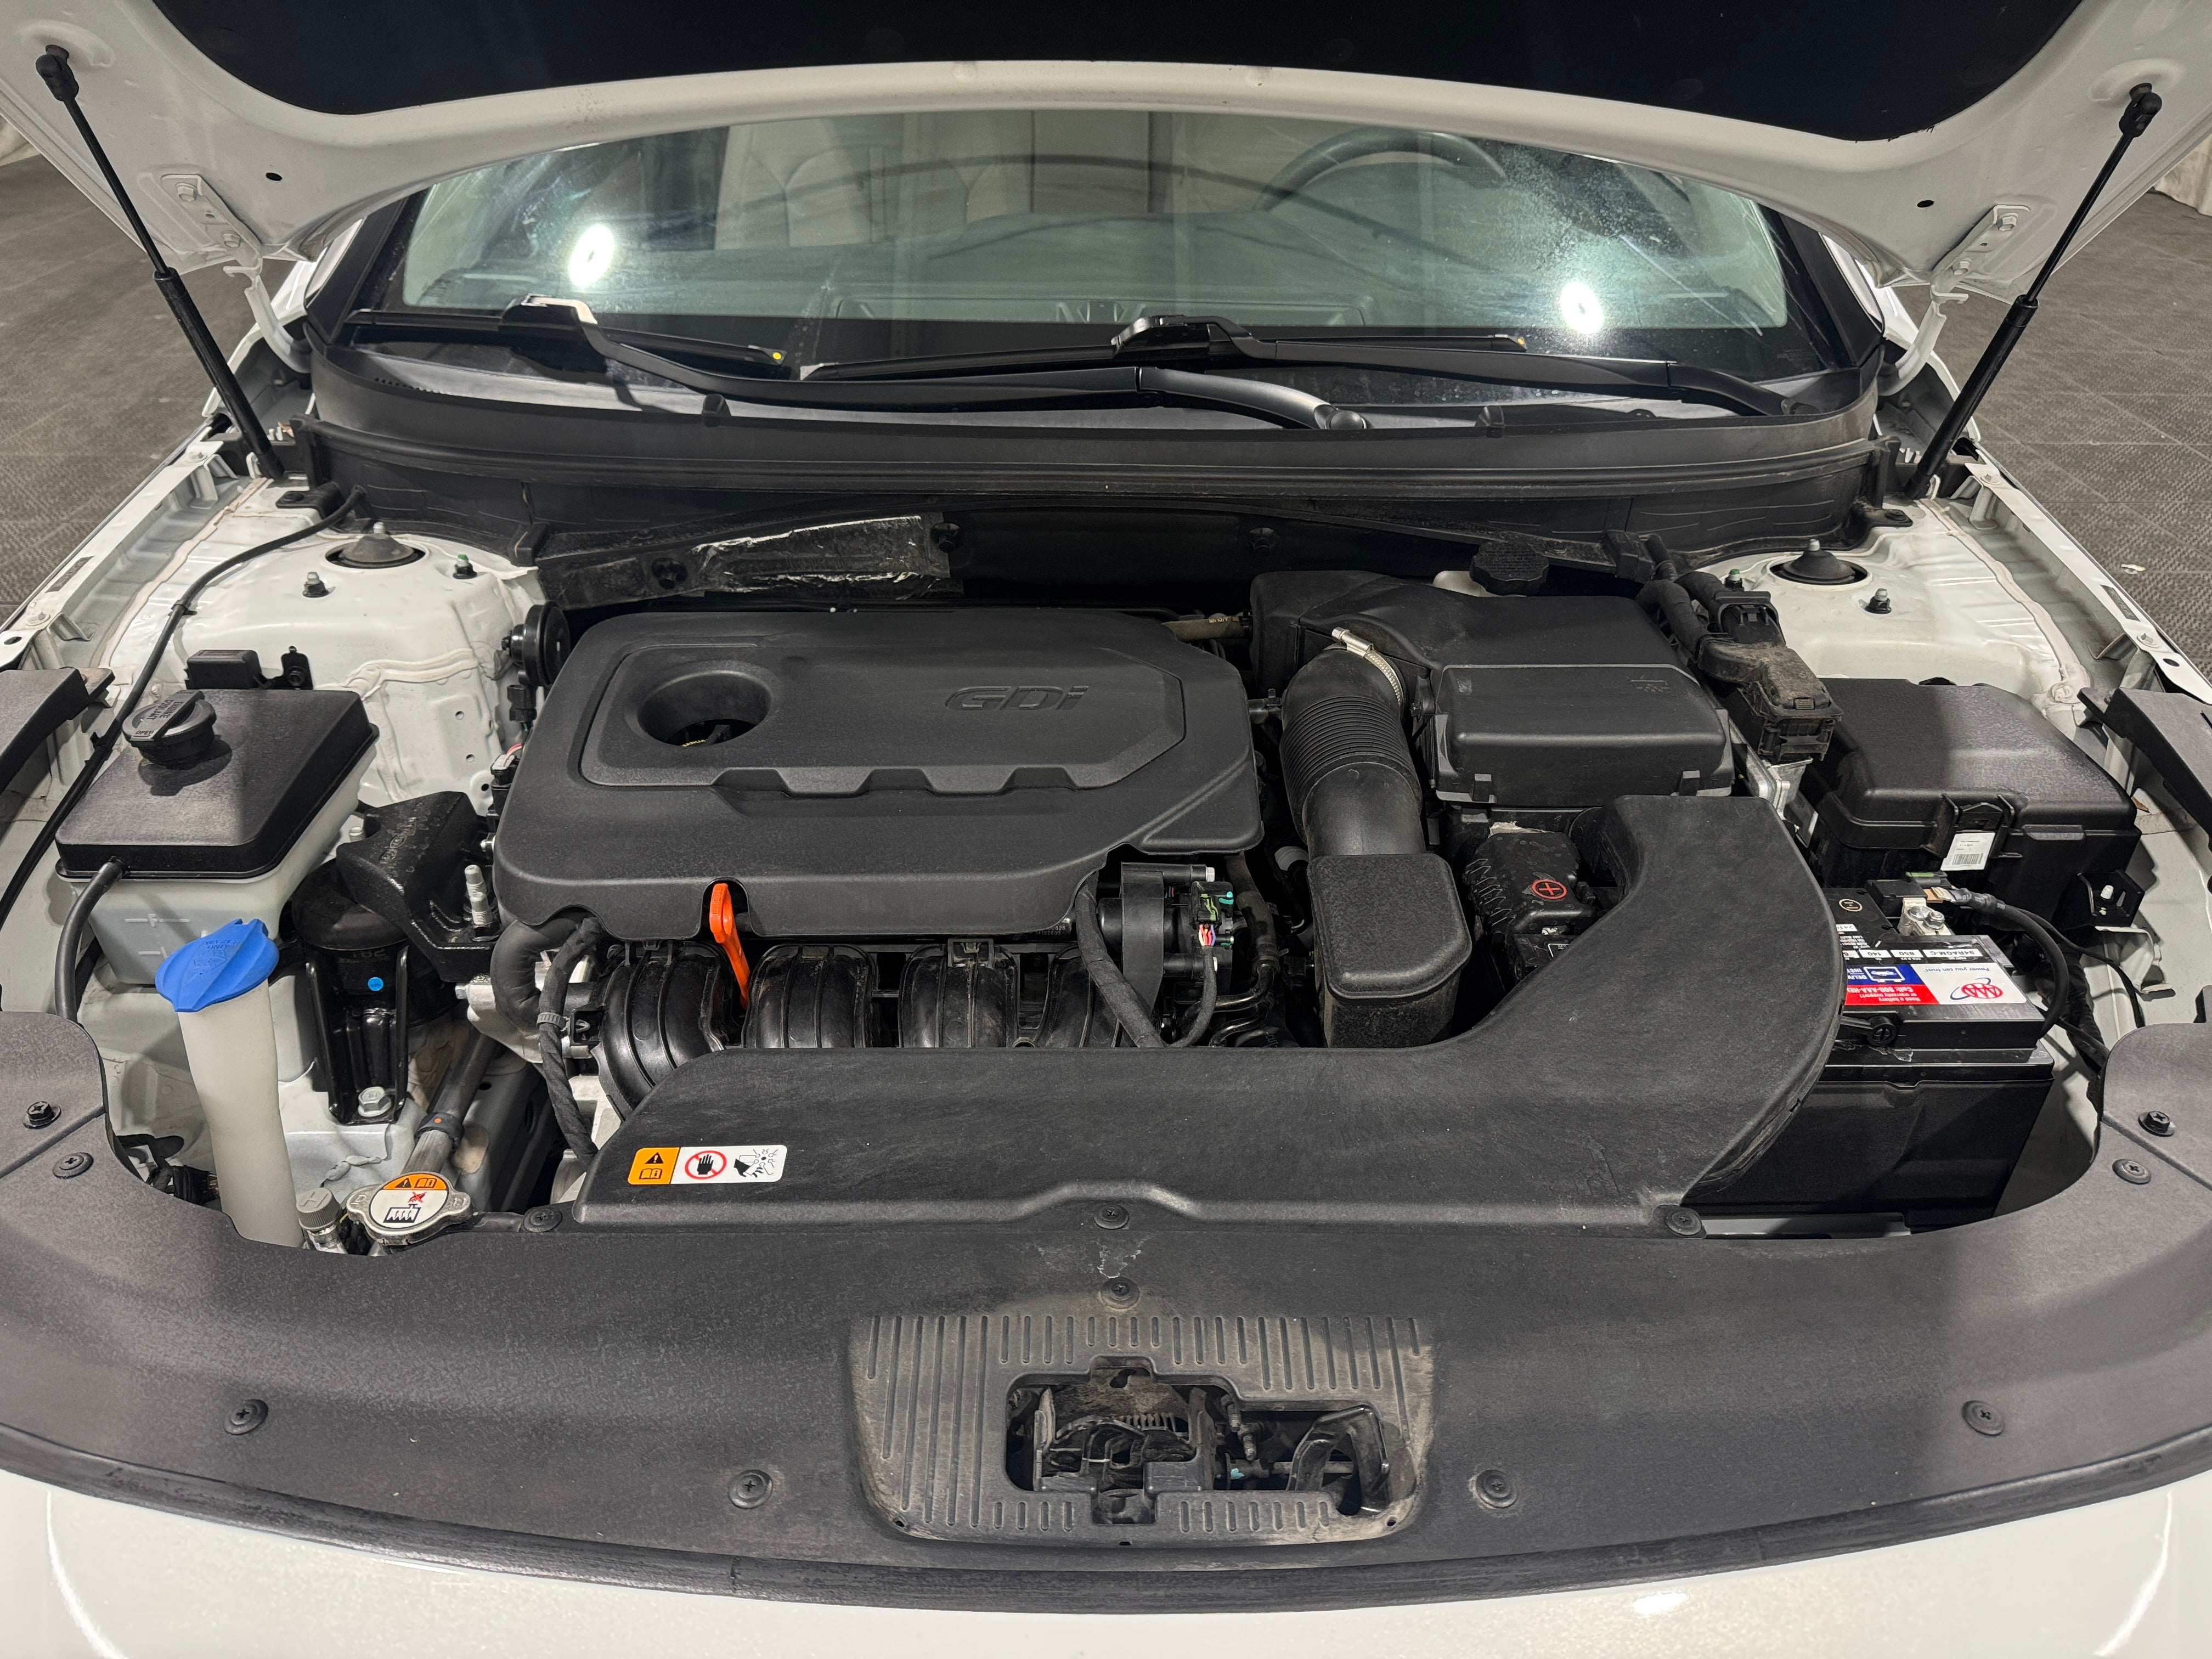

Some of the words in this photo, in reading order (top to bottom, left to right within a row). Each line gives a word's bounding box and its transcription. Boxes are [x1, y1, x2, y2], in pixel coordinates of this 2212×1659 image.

[944, 685, 1090, 711] GDi
[146, 699, 174, 721] COOLANT
[159, 701, 184, 719] ENGINE
